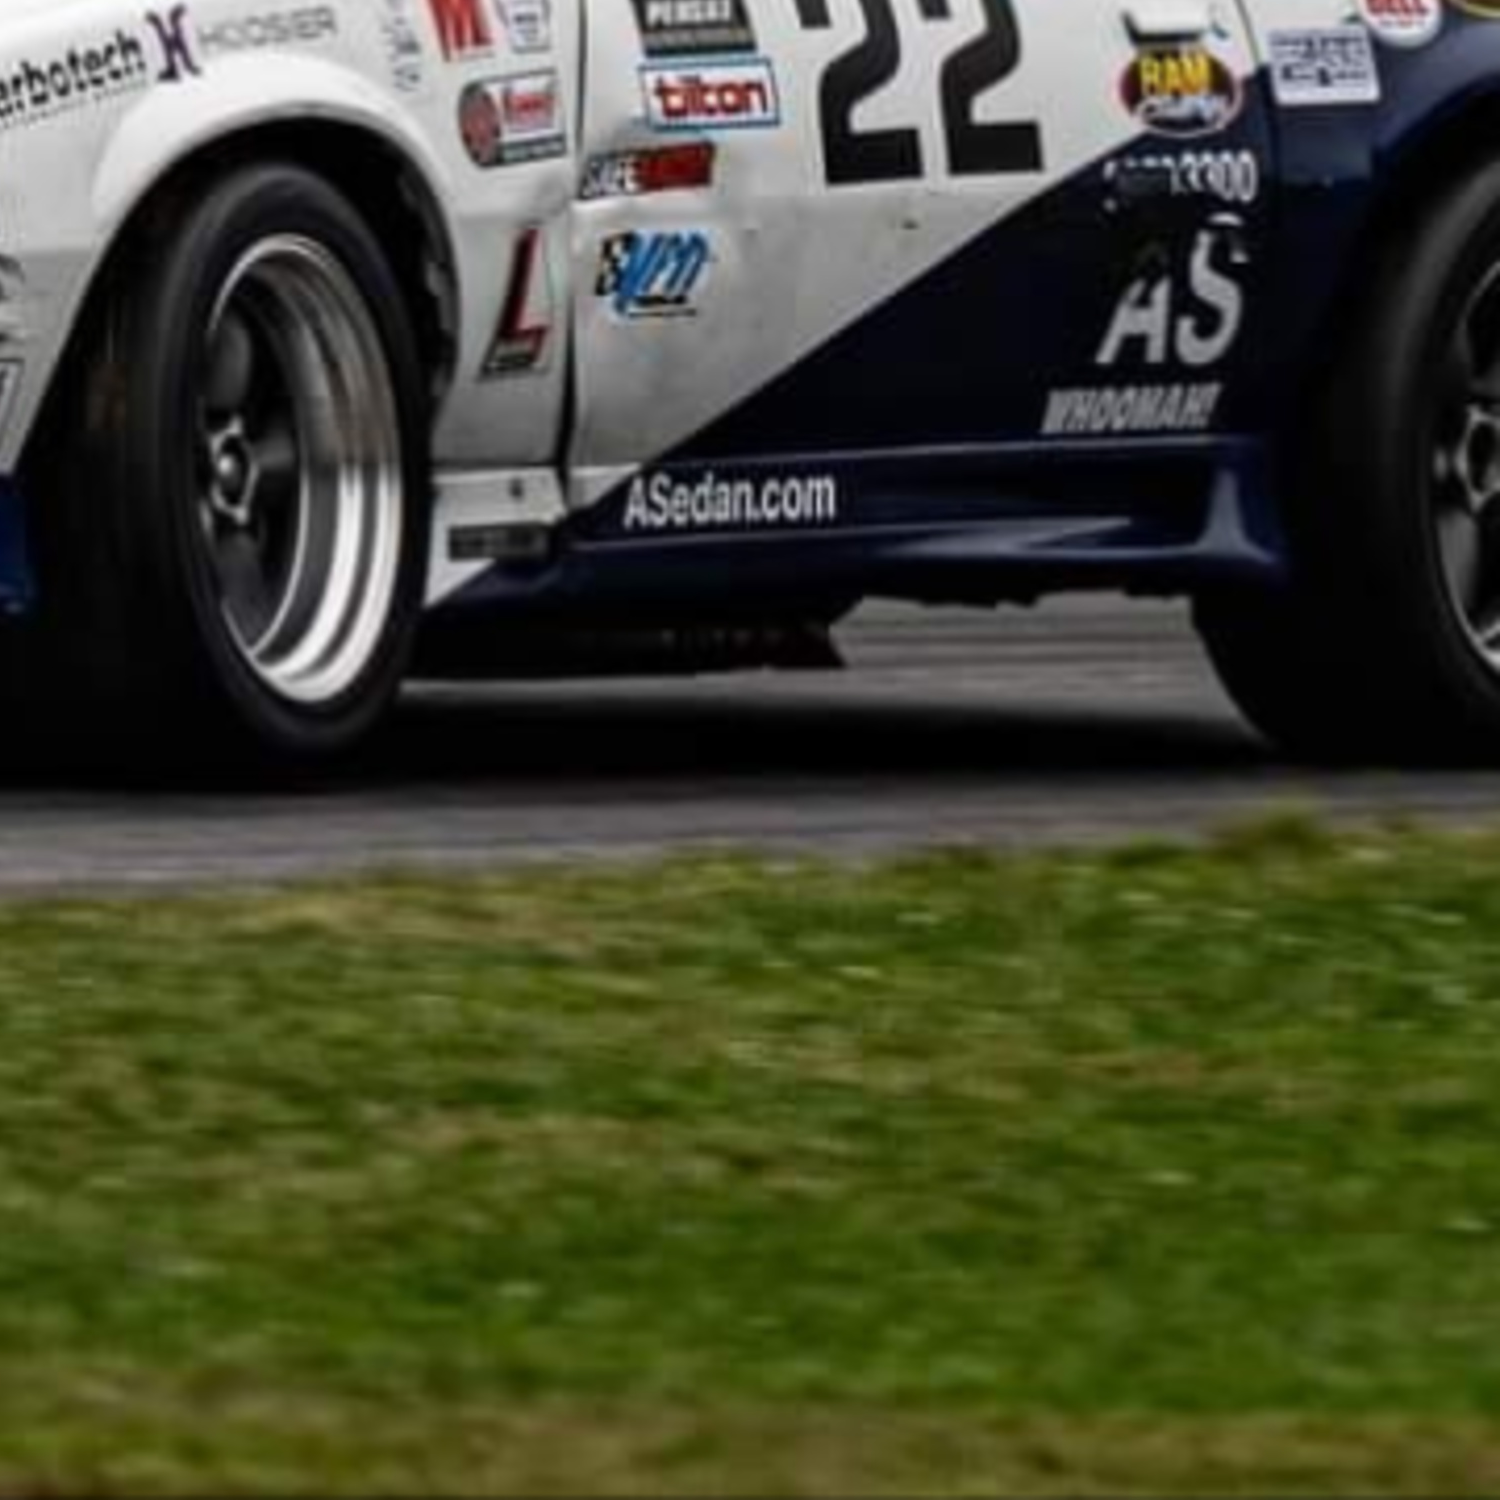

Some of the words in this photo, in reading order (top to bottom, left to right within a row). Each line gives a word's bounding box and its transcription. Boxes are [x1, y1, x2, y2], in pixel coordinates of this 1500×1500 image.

[200, 5, 338, 51] HOOSIER
[653, 73, 769, 119] tilton
[1095, 211, 1249, 367] AS
[622, 468, 836, 531] ASedan.com
